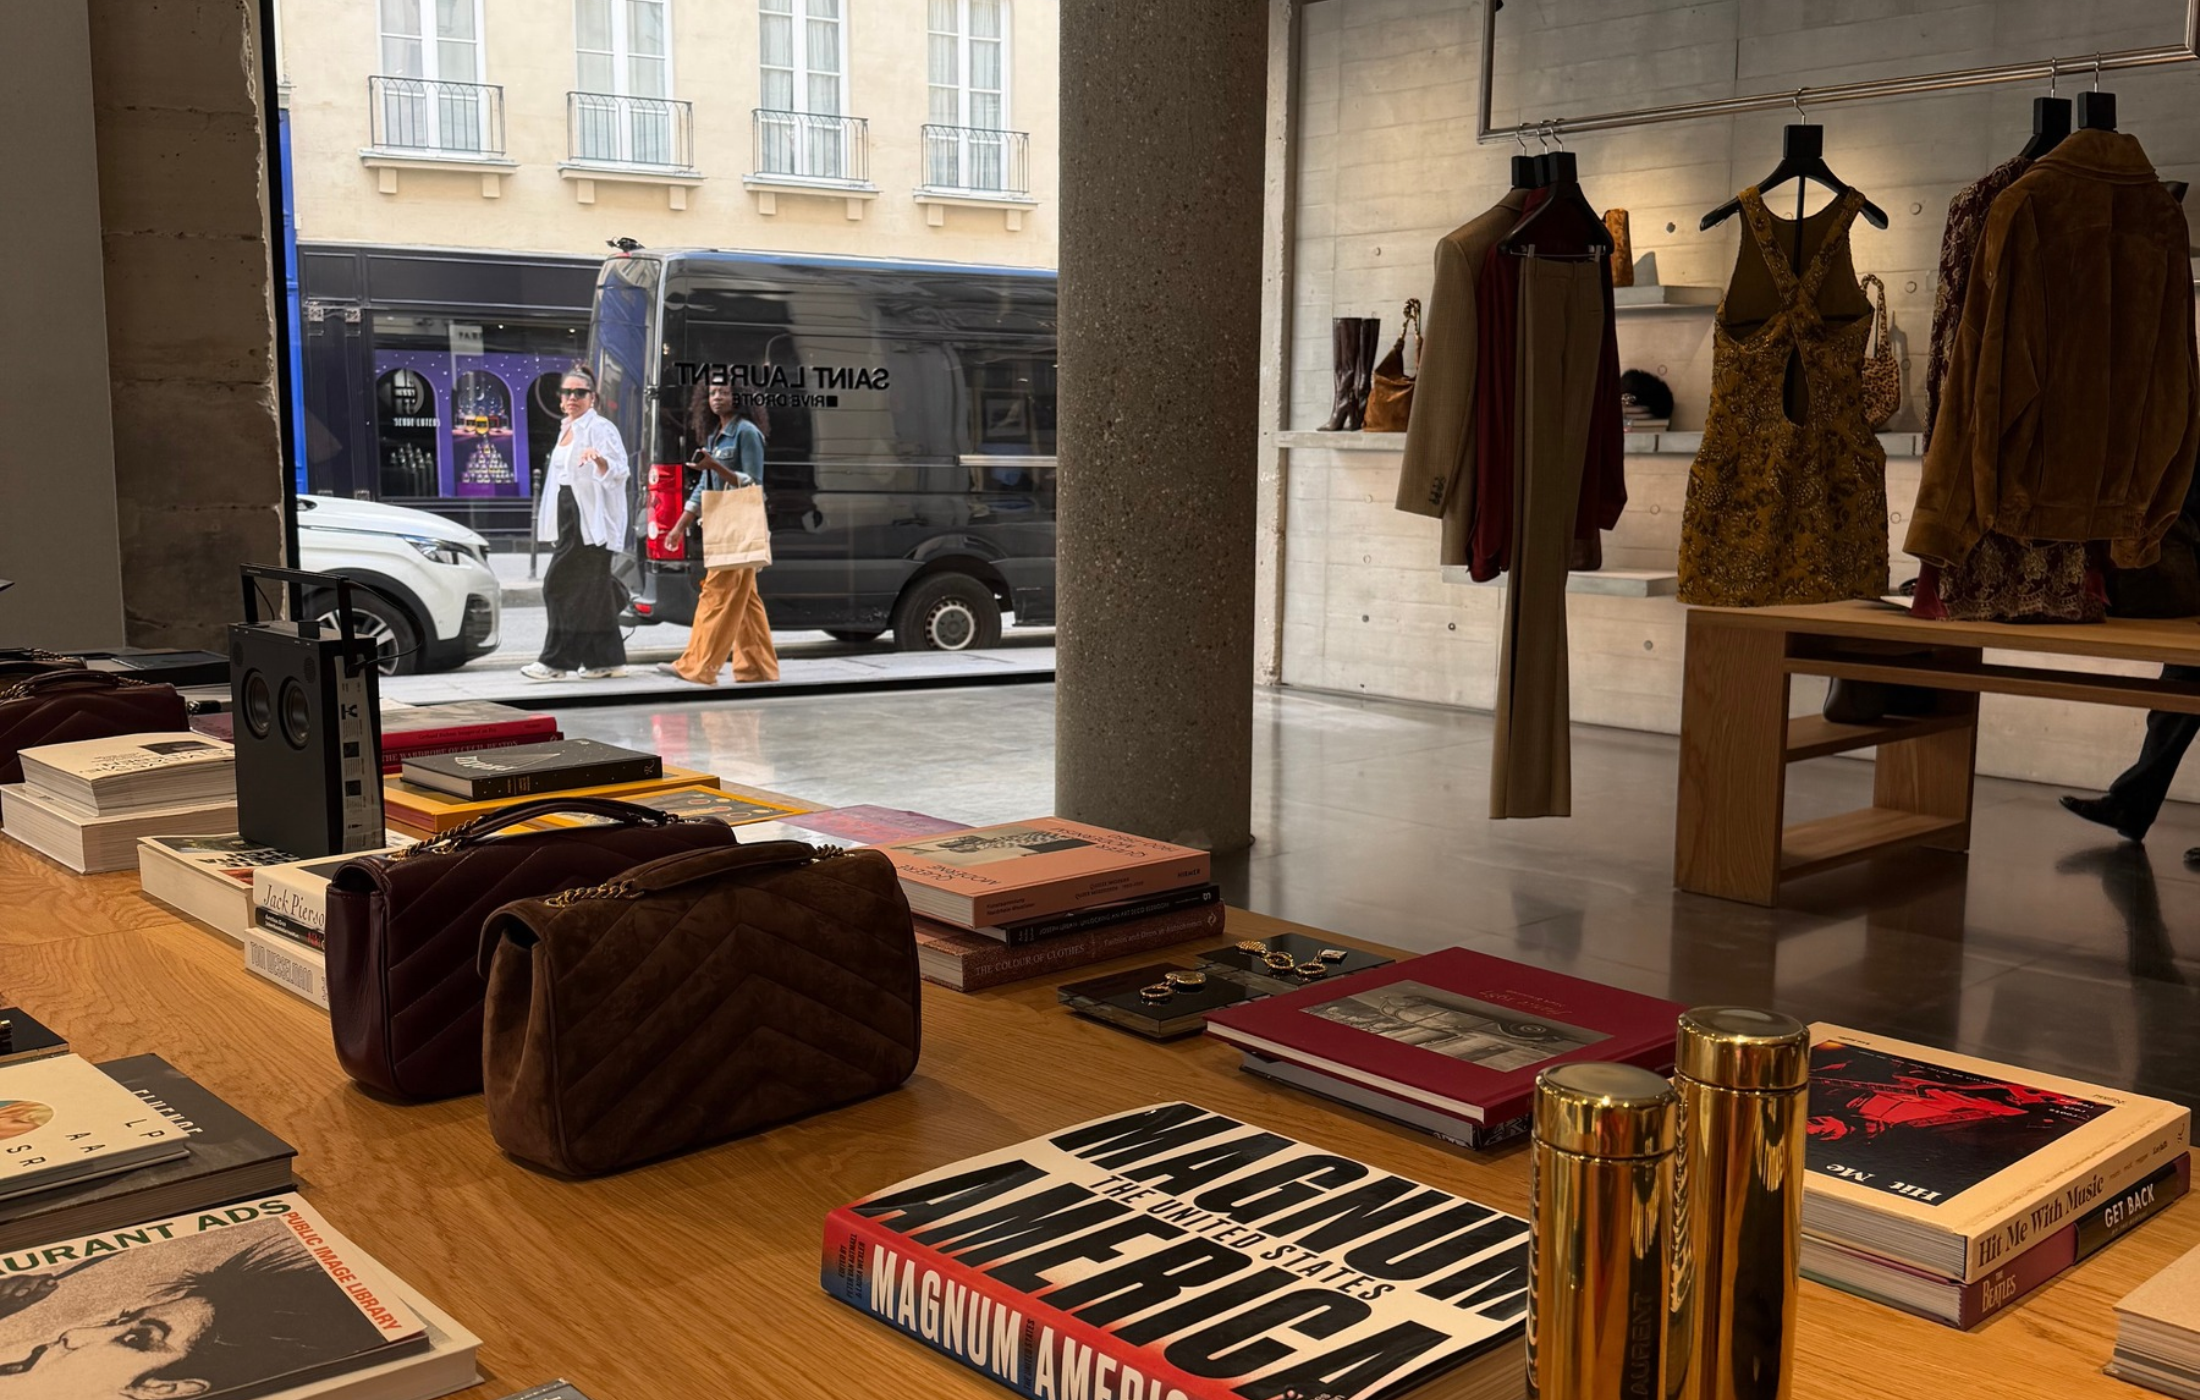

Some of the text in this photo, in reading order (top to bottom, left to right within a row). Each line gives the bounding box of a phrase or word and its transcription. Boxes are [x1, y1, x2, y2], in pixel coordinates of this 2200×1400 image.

[263, 883, 290, 915] Jack
[291, 893, 325, 927] Pierso
[974, 965, 994, 978] THE
[994, 956, 1033, 973] COLOUR
[1032, 953, 1046, 965] OF
[1046, 944, 1086, 961] CLOTHES
[138, 1129, 166, 1139] P
[2048, 1107, 2079, 1118] roots
[5, 1143, 34, 1155] S
[65, 1131, 107, 1154] A A
[1825, 1163, 1943, 1203] Hit Me
[1048, 1102, 1530, 1322] MAGNUM
[1978, 1233, 2003, 1268] Hit
[2004, 1219, 2029, 1253] Me
[2030, 1198, 2064, 1235] With
[2065, 1173, 2105, 1216] Music
[2103, 1182, 2156, 1229] GET BACK
[0, 1199, 293, 1276] URANT ADS
[1089, 1174, 1397, 1302] THE UNITED STATES
[282, 1211, 403, 1331] PUBLIC IMAGE LIBRARY
[838, 1244, 848, 1279] EDITED BY
[851, 1158, 1454, 1400] AMERICA
[1994, 1270, 2004, 1281] THE
[846, 1277, 855, 1299] PETER
[1980, 1273, 2018, 1314] BEATLES
[869, 1243, 1023, 1386] MAGNUM
[1023, 1318, 1036, 1391] THE UNITED STATES
[1629, 1291, 1652, 1400] AURENT
